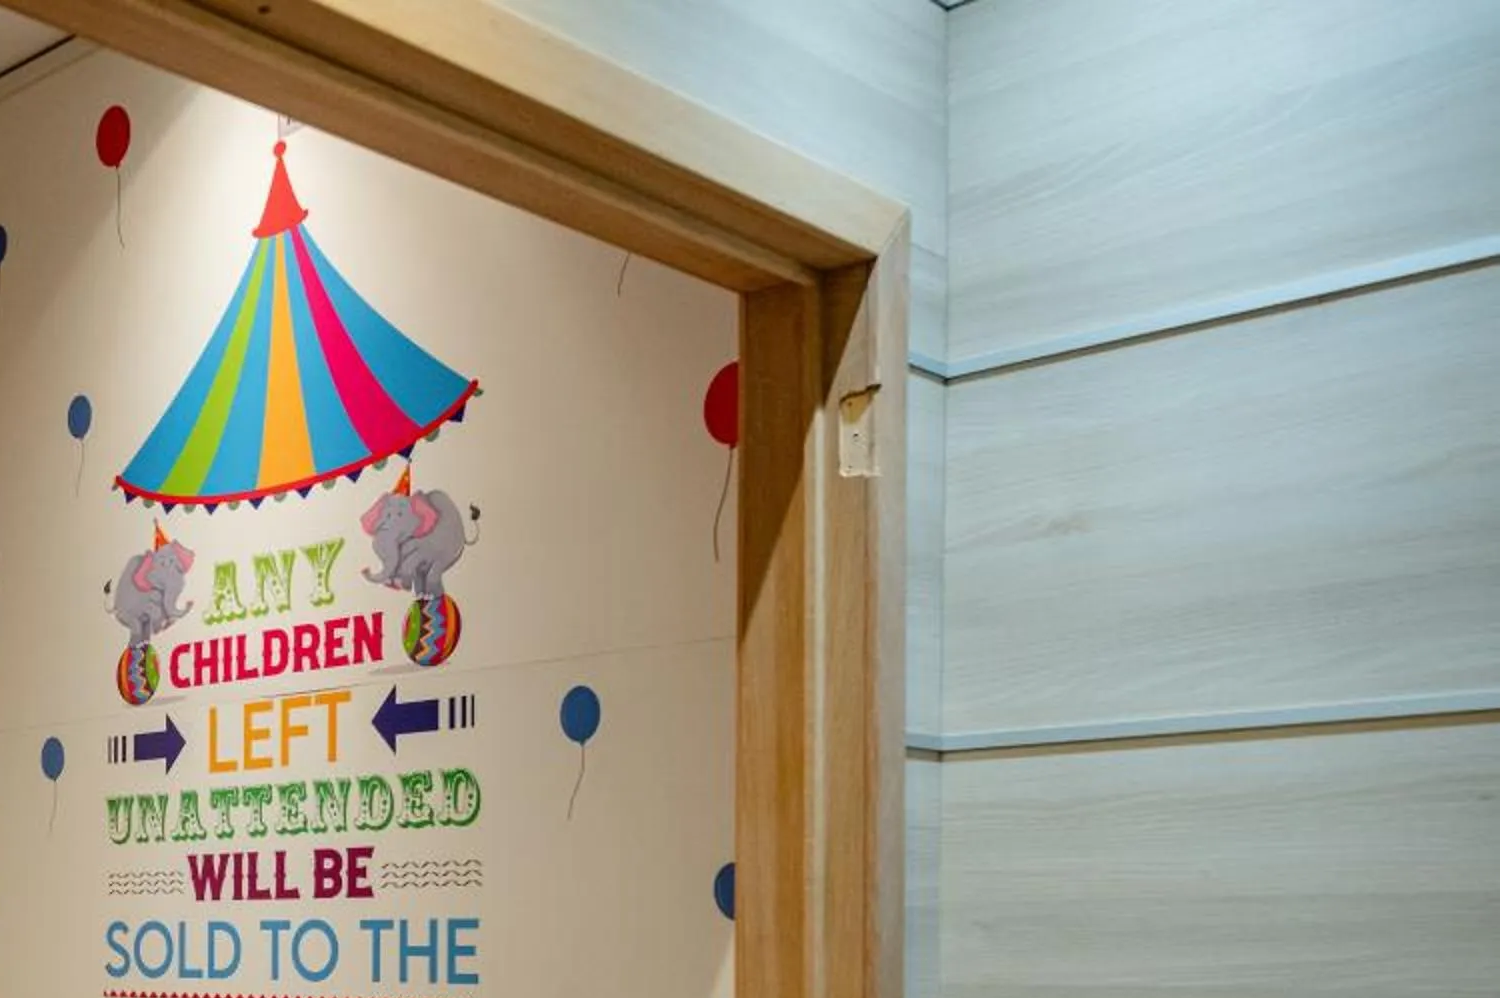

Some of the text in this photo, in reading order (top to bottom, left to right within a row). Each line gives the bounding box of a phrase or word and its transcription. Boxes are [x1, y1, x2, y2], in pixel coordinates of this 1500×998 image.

[203, 537, 345, 625] ANY
[169, 611, 384, 689] CHILDREN
[208, 690, 352, 773] LEFT
[105, 767, 482, 845] UNATTENDED
[188, 846, 375, 901] WILL BE
[105, 918, 480, 985] SOLD TO THE
